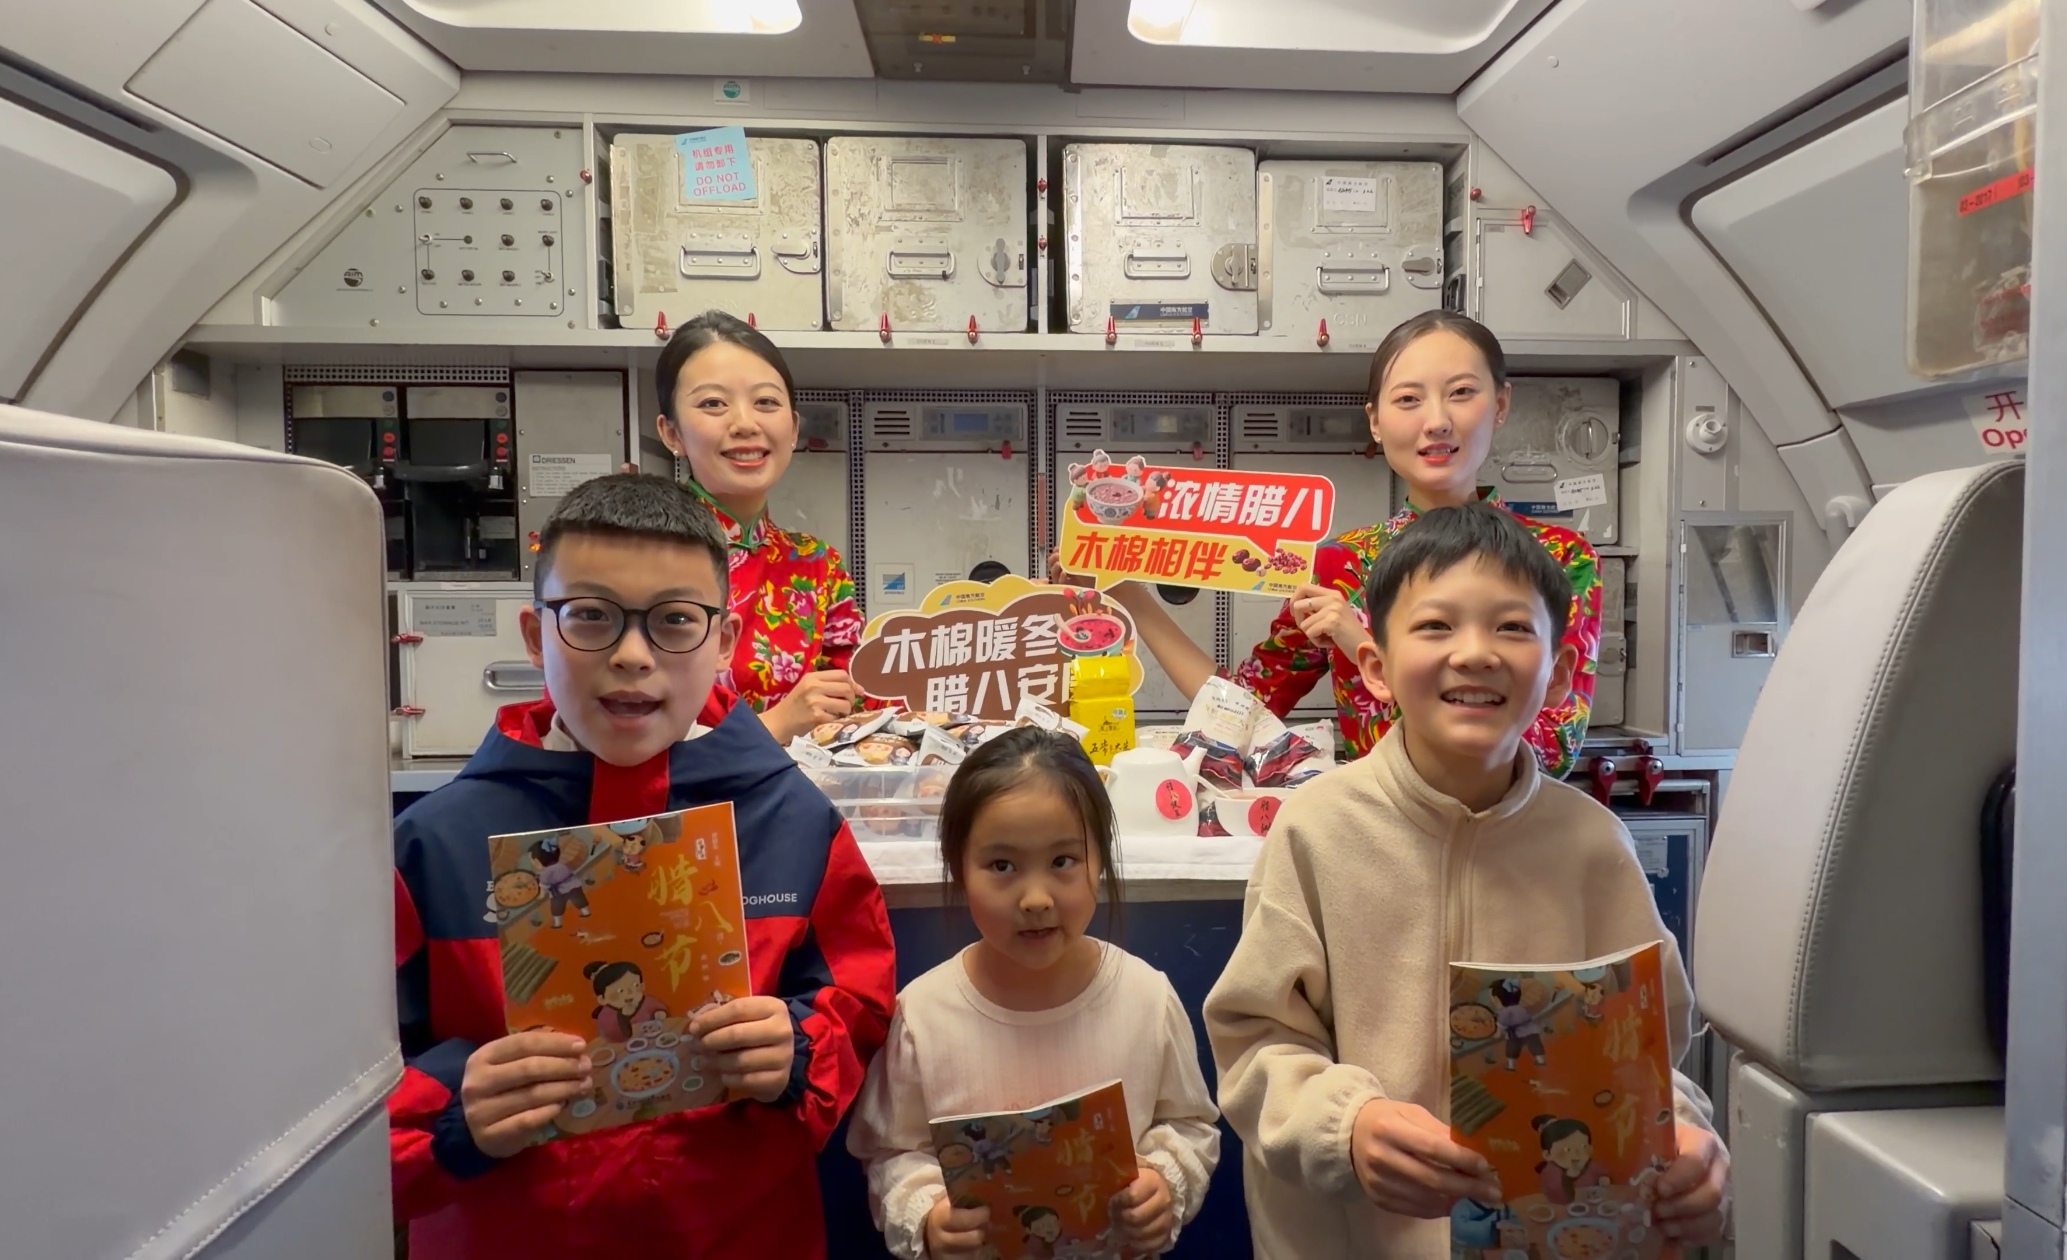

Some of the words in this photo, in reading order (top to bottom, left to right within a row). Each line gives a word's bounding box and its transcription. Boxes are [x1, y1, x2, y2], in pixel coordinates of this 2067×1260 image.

[692, 144, 734, 158] 机组专用
[694, 157, 736, 171] 请勿卸下
[693, 182, 746, 197] OFFLOAD
[696, 176, 713, 186] DO
[716, 172, 740, 183] NOT
[1984, 390, 2024, 422] 开
[541, 456, 576, 464] DRIESSEN
[1157, 478, 1324, 531] 浓情腊八
[1068, 531, 1229, 581] 木棉相伴
[881, 613, 1059, 674] 木棉暖冬
[925, 661, 1077, 717] 腊八安
